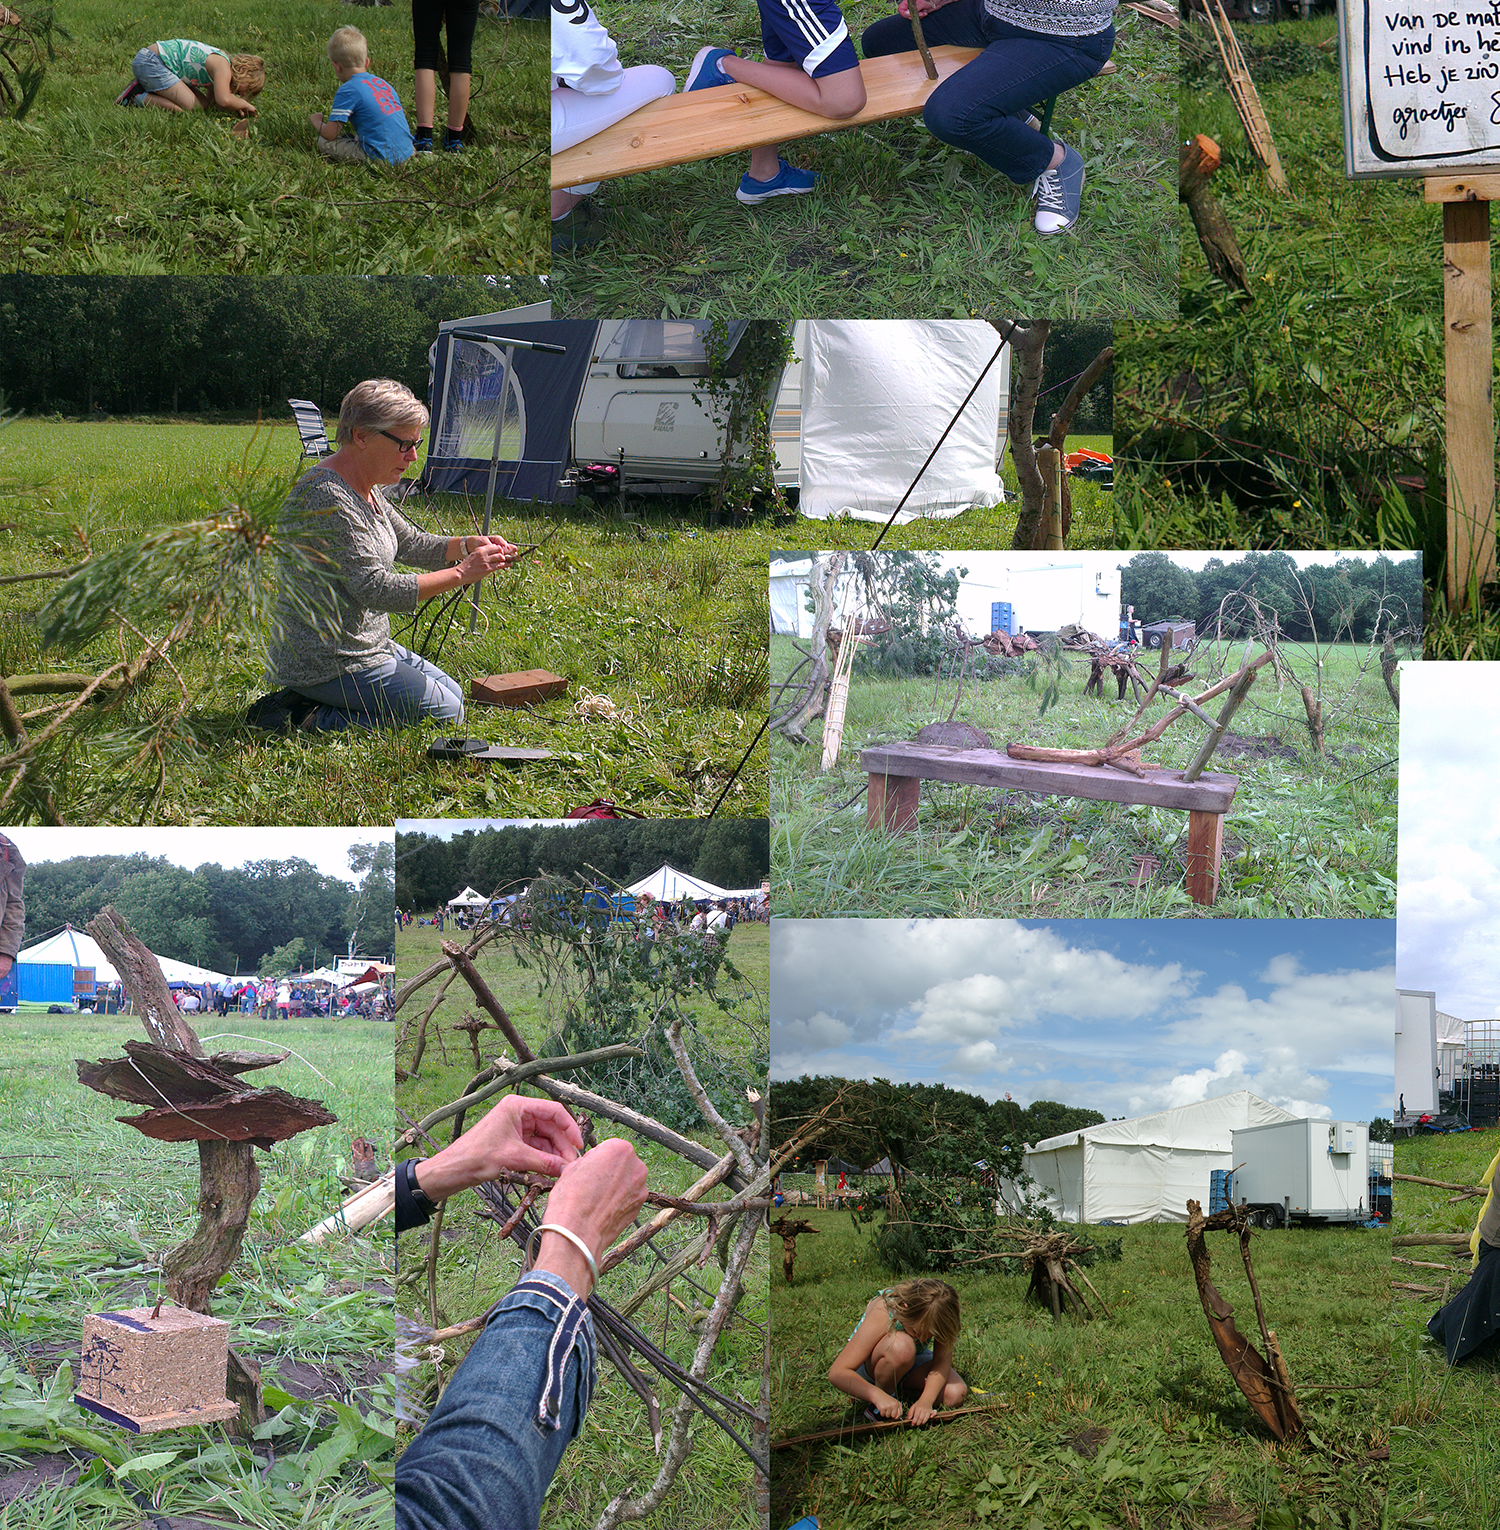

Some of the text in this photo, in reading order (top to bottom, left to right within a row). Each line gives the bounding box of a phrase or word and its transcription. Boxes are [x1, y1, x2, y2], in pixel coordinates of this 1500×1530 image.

[1385, 12, 1424, 31] van
[1392, 33, 1432, 56] vind
[1445, 35, 1471, 54] in
[1393, 100, 1467, 140] groetjes
